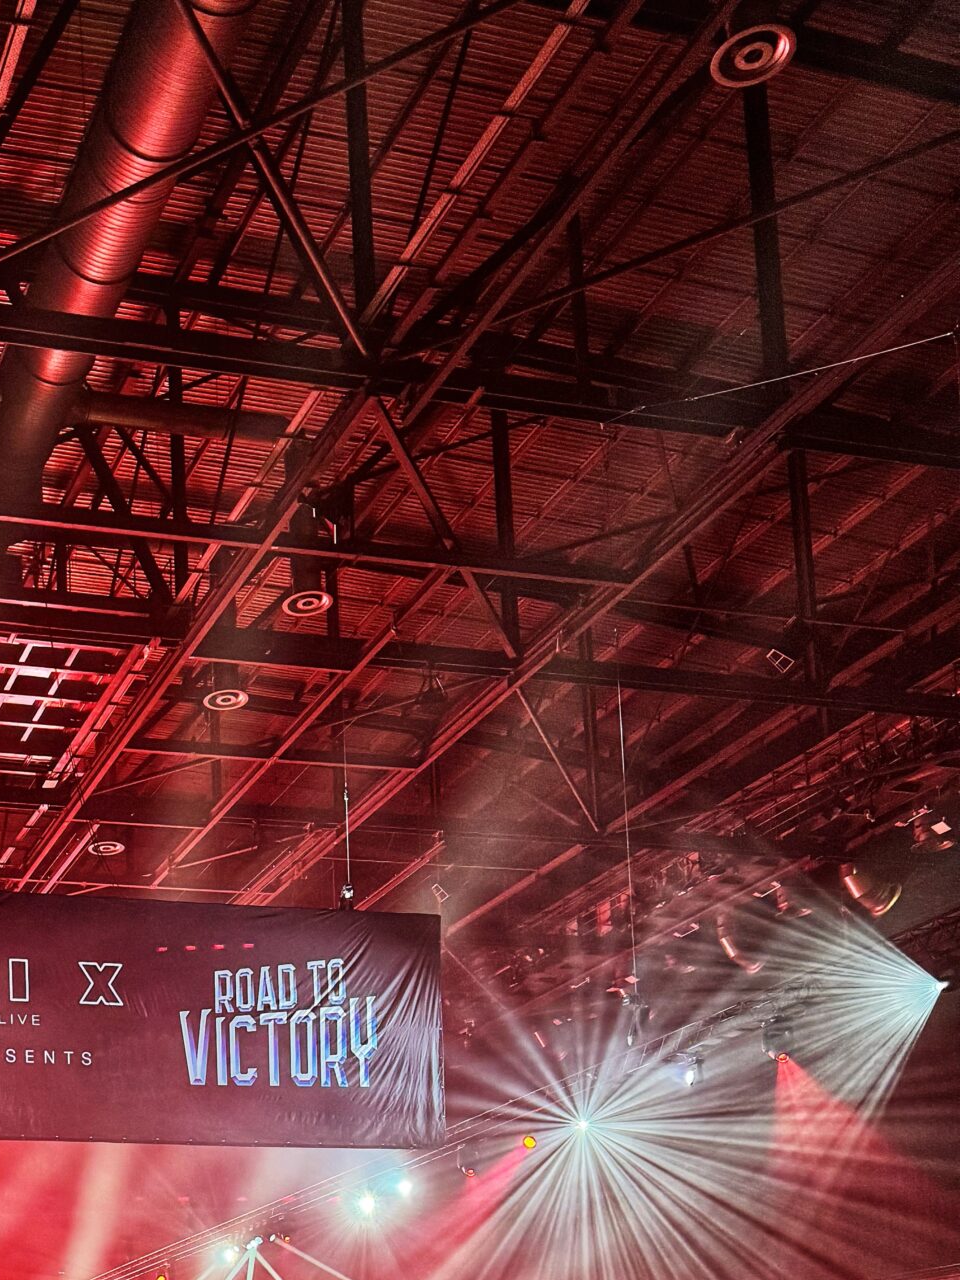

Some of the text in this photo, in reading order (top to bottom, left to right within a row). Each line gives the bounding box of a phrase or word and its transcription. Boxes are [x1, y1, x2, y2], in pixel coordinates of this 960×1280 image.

[214, 957, 348, 1014] ROAD TO
[179, 995, 378, 1088] VICTORY
